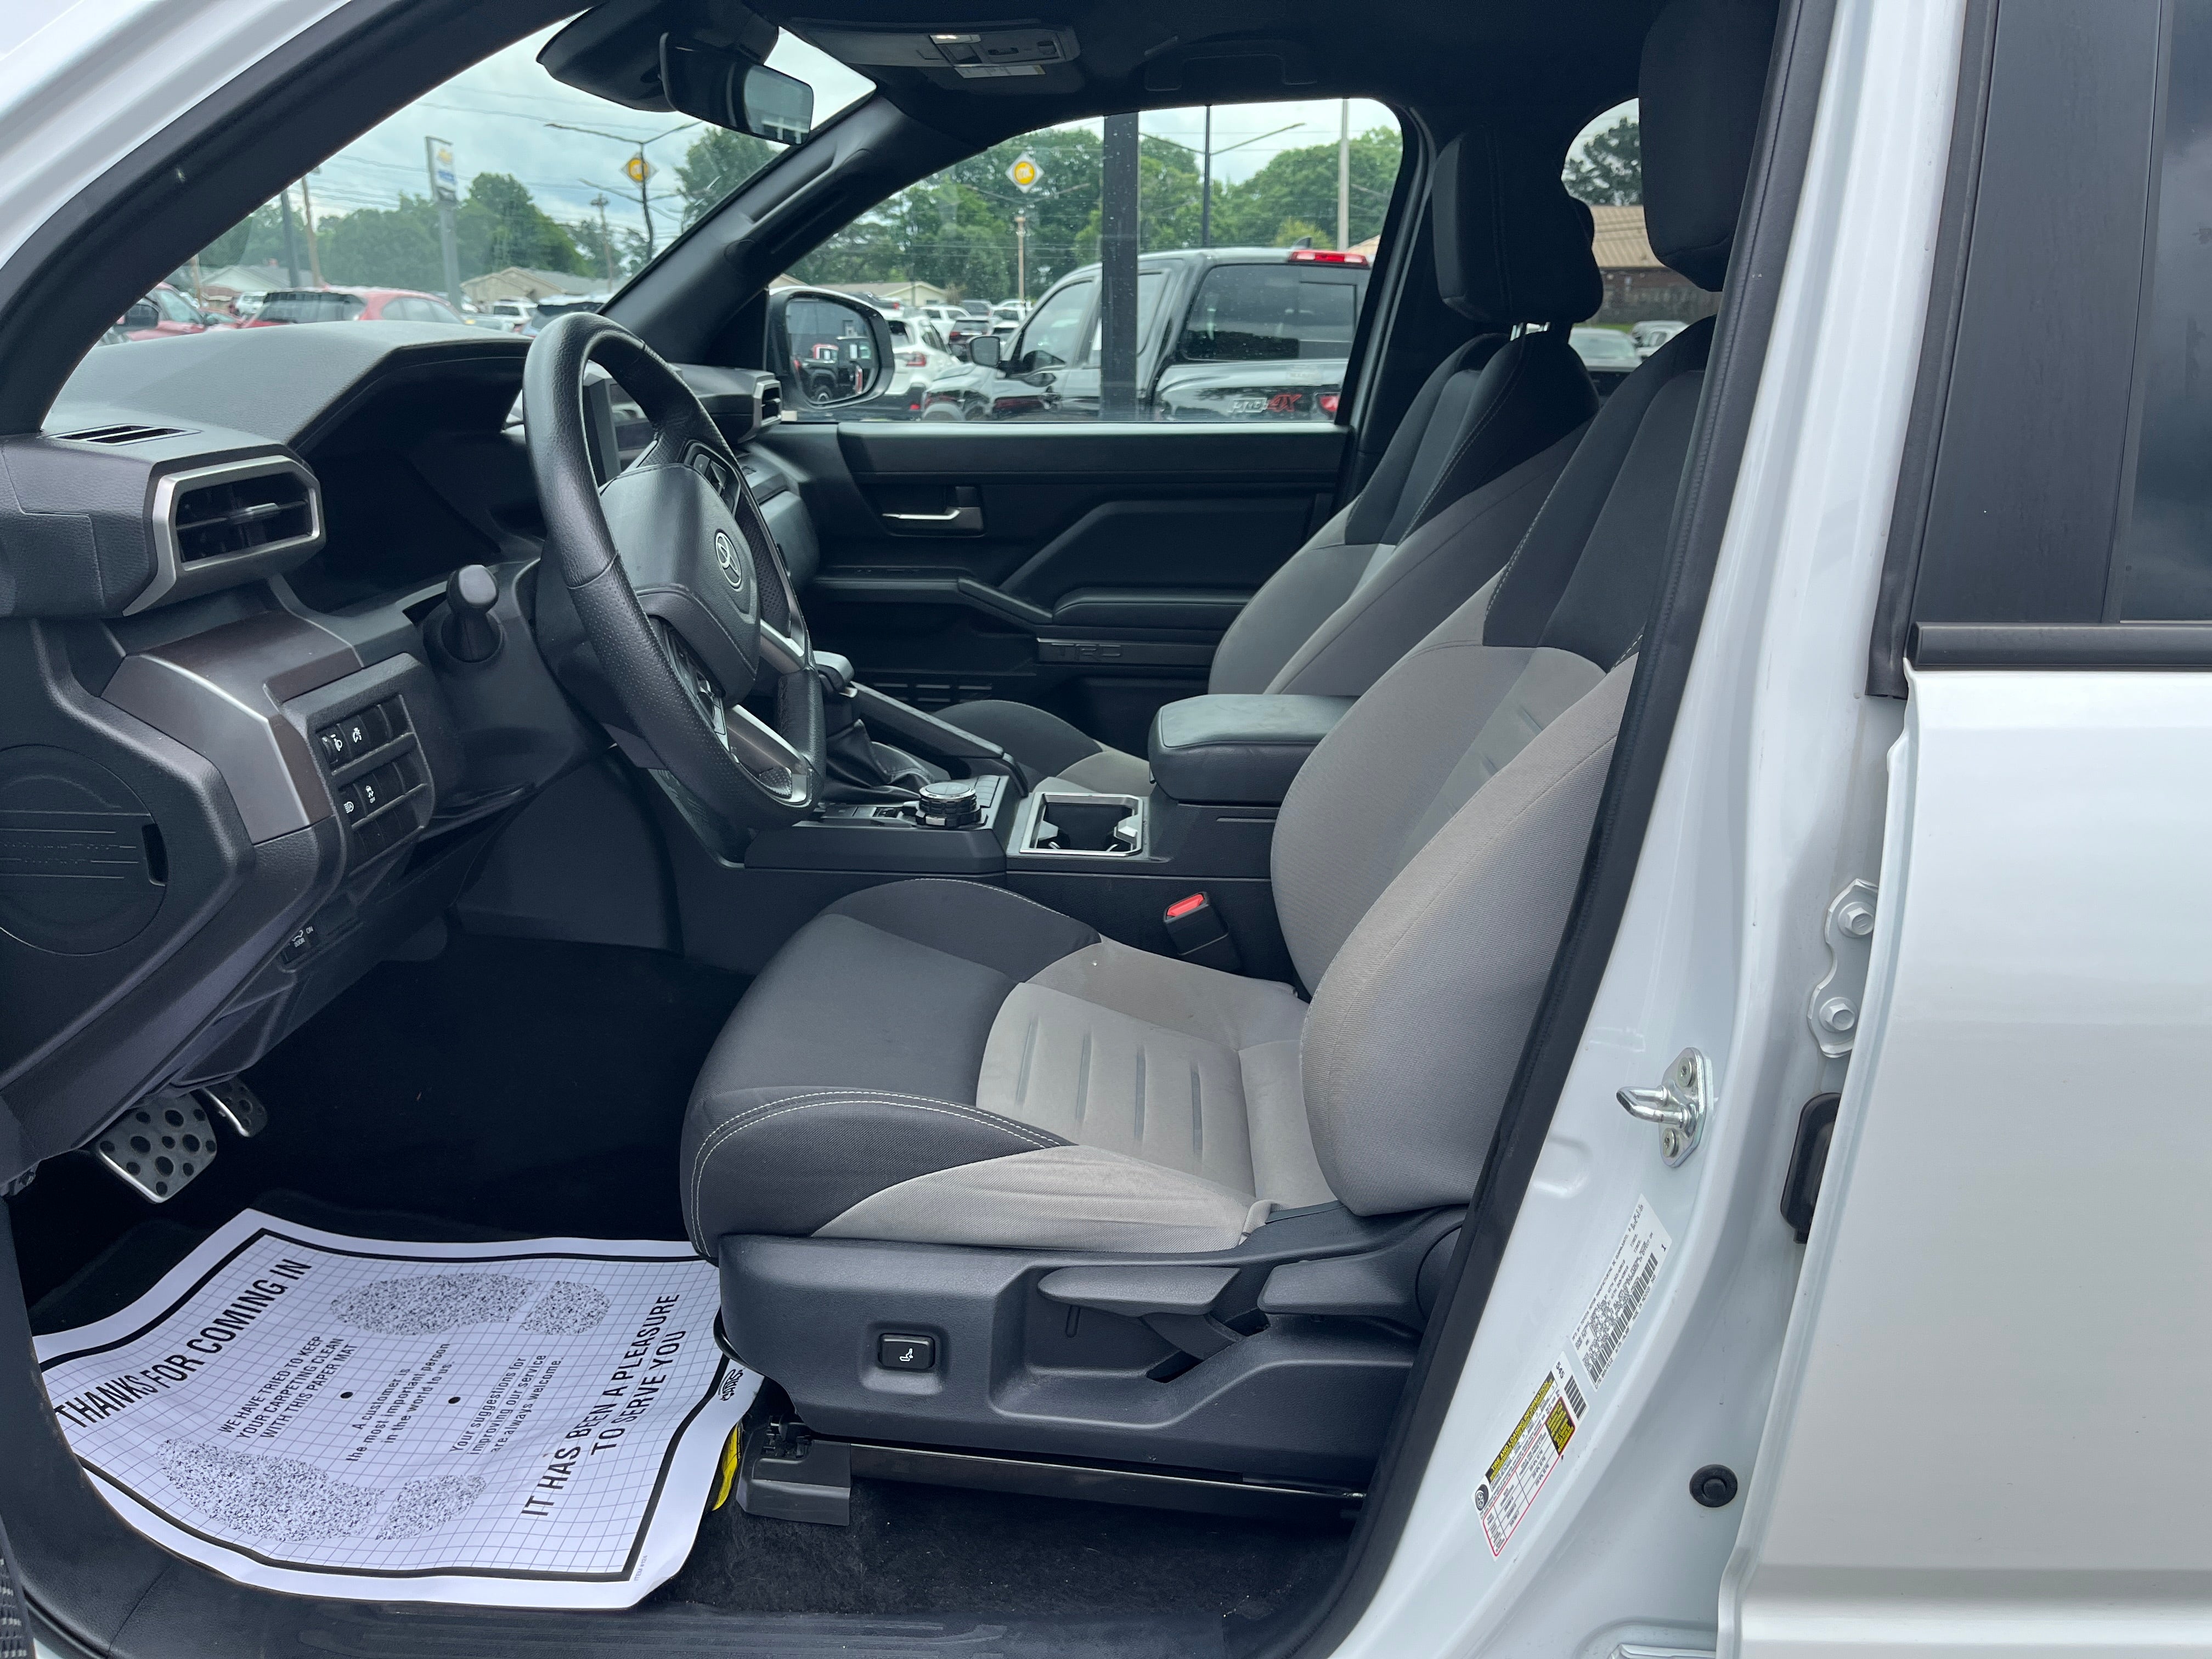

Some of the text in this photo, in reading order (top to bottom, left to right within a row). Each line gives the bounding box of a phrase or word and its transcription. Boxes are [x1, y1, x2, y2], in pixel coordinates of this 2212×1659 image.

[54, 1259, 312, 1428] THANKS FOR COMING IN
[218, 1336, 324, 1433] WE HAVE TRIED TO KEEP
[236, 1338, 345, 1438] YOUR CARPETING CLEAN
[260, 1344, 357, 1438] WITH THIS PAPER MAT
[591, 1329, 686, 1455] TO SERVE YOU
[346, 1344, 450, 1461] the most important person
[362, 1379, 402, 1420] customer
[381, 1435, 398, 1443] in
[391, 1415, 411, 1431] the
[407, 1387, 433, 1413] world
[438, 1361, 455, 1374] us.
[449, 1358, 526, 1452] Your suggestions for
[467, 1355, 546, 1454] improving our service
[490, 1357, 564, 1453] are always welcome.
[521, 1294, 680, 1516] IT HAS BEEN A PLEASURE
[1492, 1456, 1500, 1472] TIRE
[1500, 1443, 1508, 1458] AND
[1508, 1419, 1524, 1446] LOADING
[1523, 1380, 1549, 1421] INFORMATION
